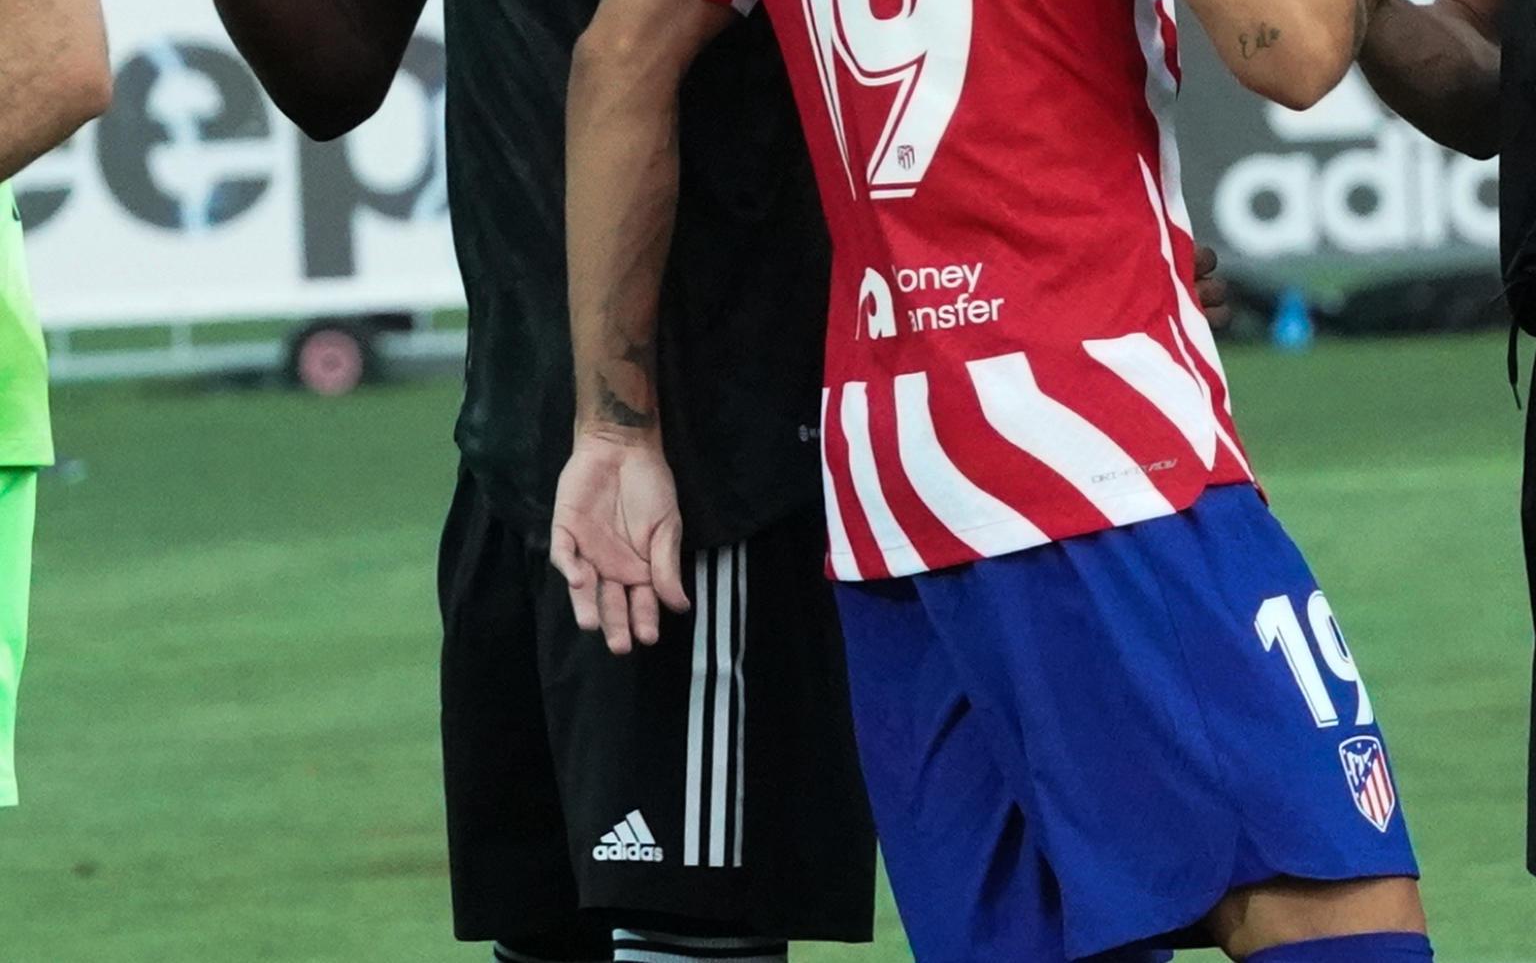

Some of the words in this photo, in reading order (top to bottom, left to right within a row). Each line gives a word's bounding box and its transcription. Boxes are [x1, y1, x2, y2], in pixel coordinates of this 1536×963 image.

[1211, 122, 1500, 260] adi
[891, 262, 983, 294] oney
[1254, 590, 1374, 728] 19
[592, 841, 664, 862] adidas
